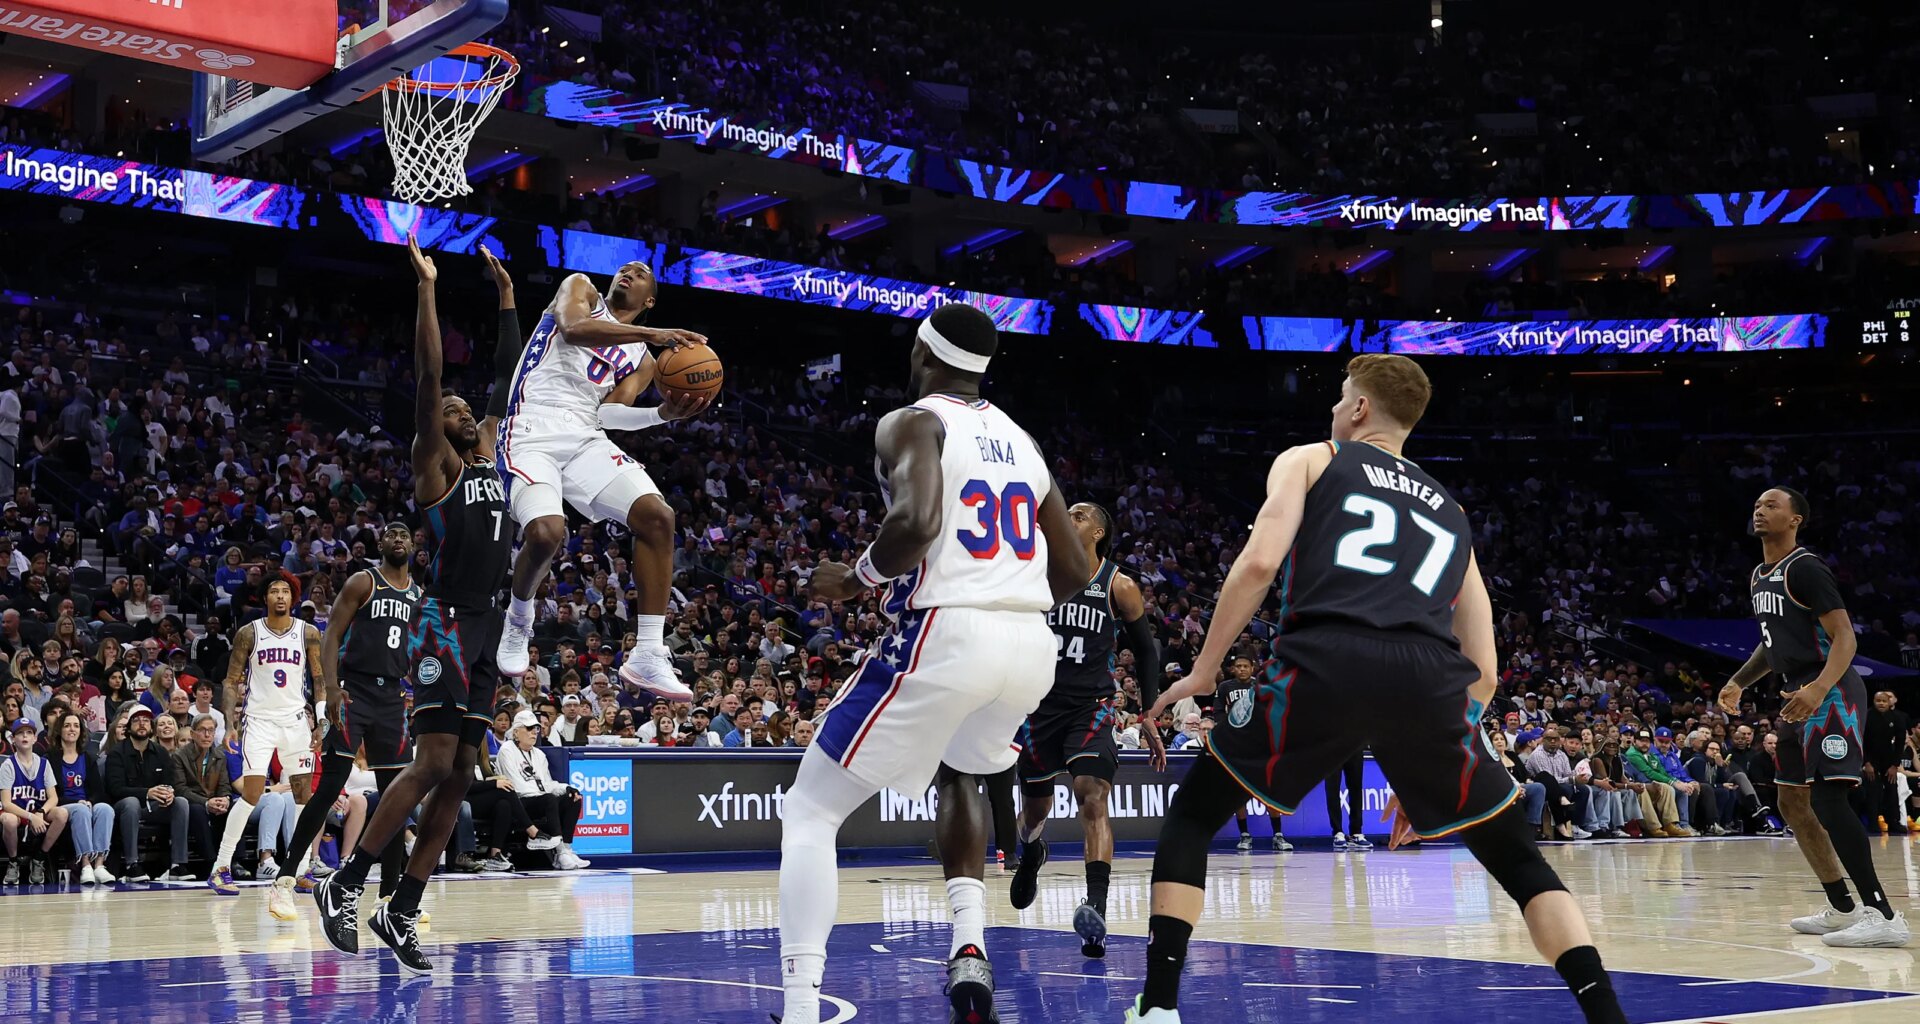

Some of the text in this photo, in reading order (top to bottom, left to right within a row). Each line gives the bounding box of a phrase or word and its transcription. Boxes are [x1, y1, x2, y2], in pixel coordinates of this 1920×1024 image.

[652, 106, 844, 160] xfinity Imagine That
[6, 151, 185, 200] Imagine That
[1340, 200, 1547, 227] xfinity Imagine That
[793, 271, 852, 301] xfinity
[858, 280, 928, 311] Imagine
[1497, 323, 1719, 349] xfinity Imagine That
[1862, 332, 1909, 343] DET 8
[1863, 320, 1909, 331] PHI 4
[1361, 463, 1445, 512] HUERTER
[490, 508, 503, 541] 7
[956, 478, 1038, 561] 30
[1334, 492, 1458, 597] 27
[1046, 602, 1107, 634] ETROIT
[387, 625, 401, 649] 8
[1760, 621, 1772, 648] 5
[274, 669, 287, 688] 9
[299, 758, 311, 768] 76
[571, 771, 629, 797] Super
[586, 795, 627, 820] Lyte
[697, 782, 785, 828] xfinit
[880, 785, 939, 822] IMAG
[1141, 784, 1164, 817] IN
[608, 826, 622, 834] ADE
